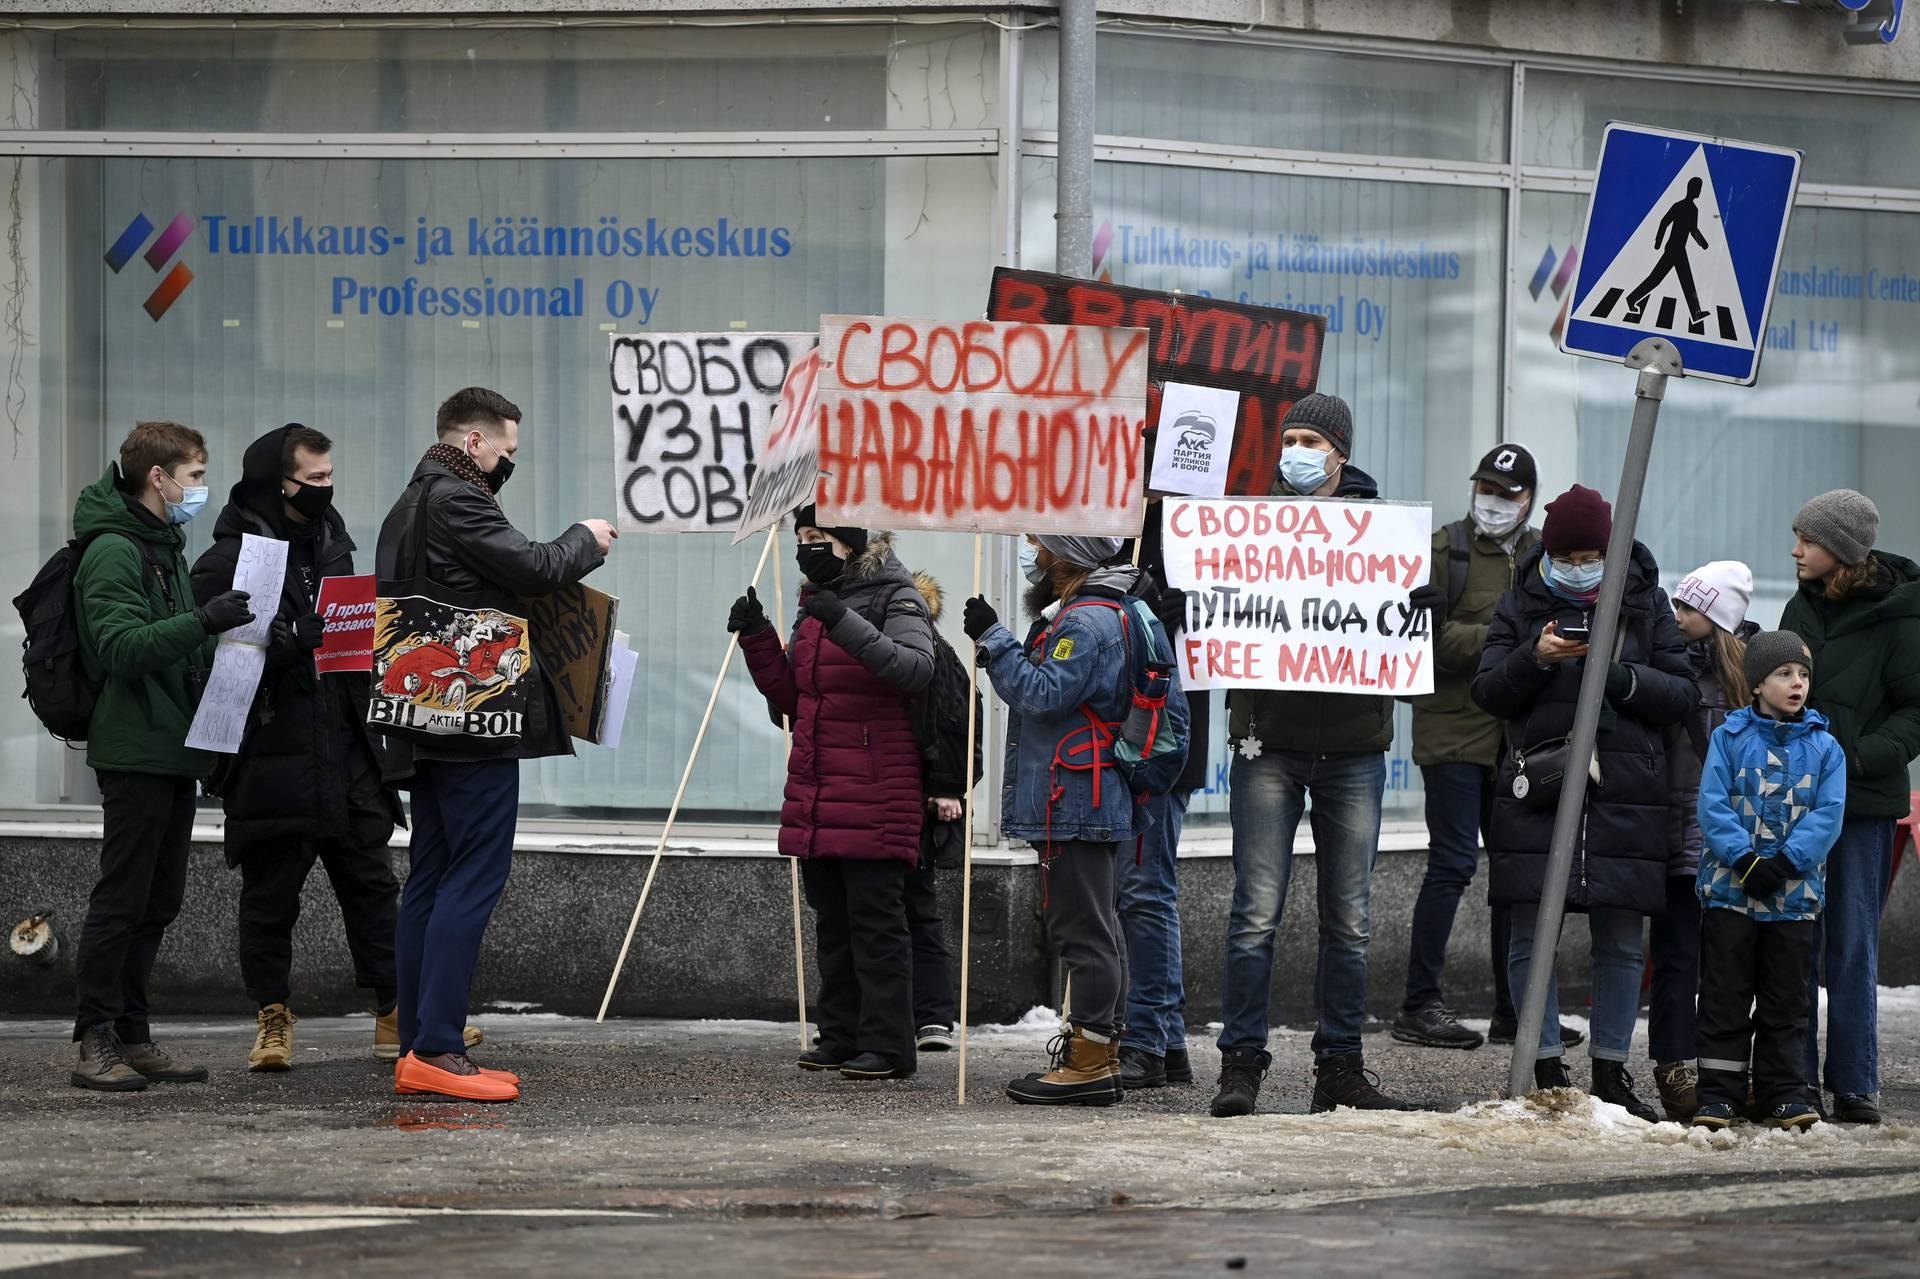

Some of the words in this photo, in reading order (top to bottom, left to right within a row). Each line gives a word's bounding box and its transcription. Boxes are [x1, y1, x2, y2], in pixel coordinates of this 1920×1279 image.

[201, 215, 405, 255] Tulkkaus-
[414, 216, 454, 265] ja
[468, 216, 792, 257] käännöskeskus
[1118, 224, 1241, 269] Tulkkaus-
[1245, 232, 1270, 280] ja
[1278, 233, 1460, 280] käännöskeskus
[332, 276, 584, 317] Professional
[606, 279, 660, 325] Oy
[1867, 266, 1920, 303] Cente
[1356, 298, 1386, 341] Oy
[1809, 320, 1839, 352] Ltd
[610, 337, 820, 395] СВОБО
[837, 322, 1146, 397] СВОБОДУ
[619, 399, 778, 463] УЗН
[1173, 448, 1212, 460] ПАРТИЯ
[817, 399, 1144, 517] НАВАЛЬНОМУ
[1172, 456, 1210, 467] ЖУЛИКОВ
[1180, 463, 1210, 473] ВОРОВ
[1194, 543, 1423, 590] НАВАЛЬНОМУ
[323, 602, 337, 618] Я
[1183, 586, 1292, 634] ПУТИНА
[1301, 597, 1368, 634] ПОД
[1376, 600, 1430, 642] СУД
[1185, 638, 1265, 681] FREE
[1278, 642, 1423, 690] NAVALNY
